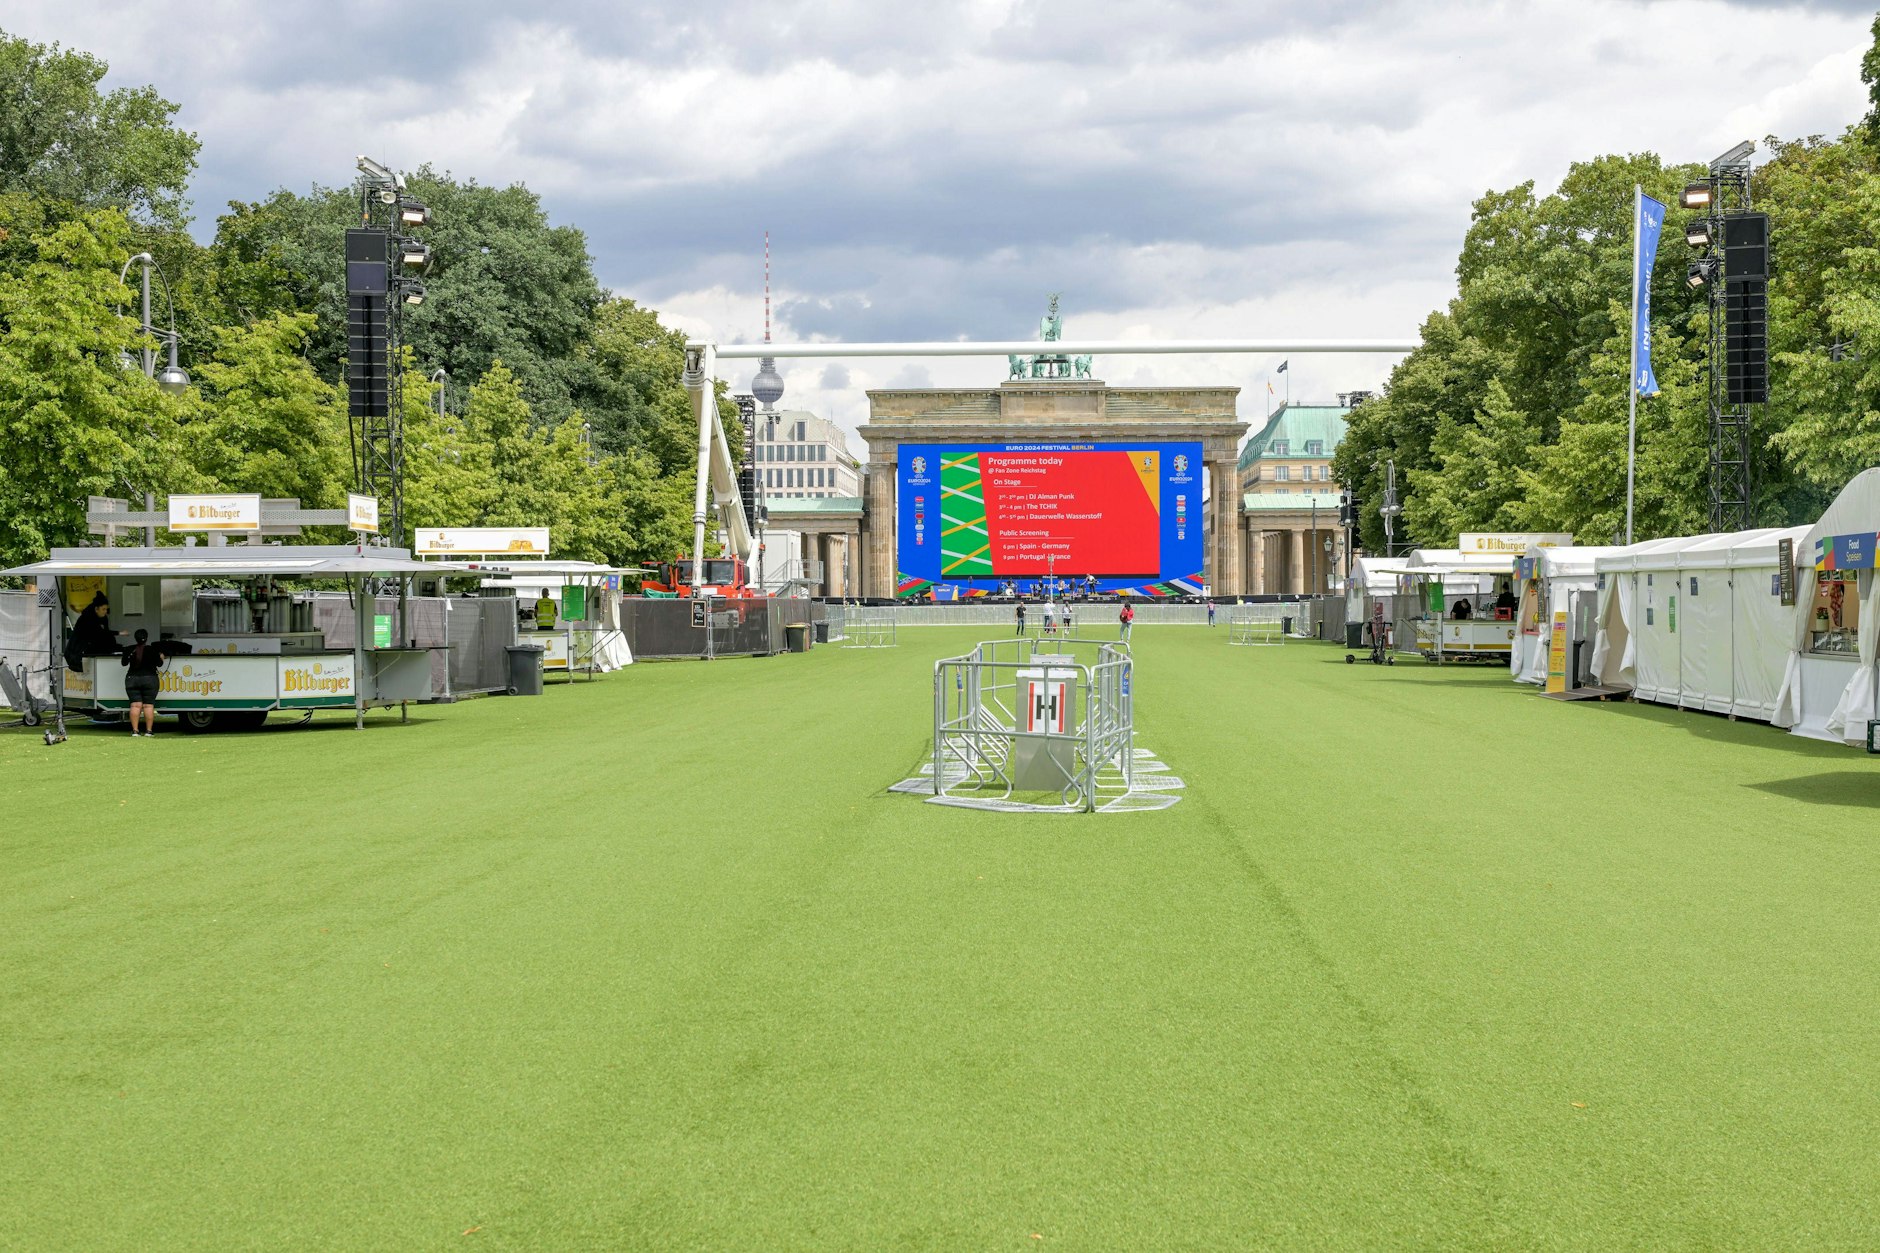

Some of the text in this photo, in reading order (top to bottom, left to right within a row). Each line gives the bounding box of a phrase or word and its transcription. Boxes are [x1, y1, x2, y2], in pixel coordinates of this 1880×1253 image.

[988, 456, 1063, 467] Programme today
[198, 505, 241, 520] Bitburger
[1487, 538, 1527, 551] Bitburger
[1848, 539, 1860, 550] Food
[1019, 553, 1045, 561] Portugal
[284, 668, 350, 693] Bitburger
[1036, 695, 1057, 720] H
